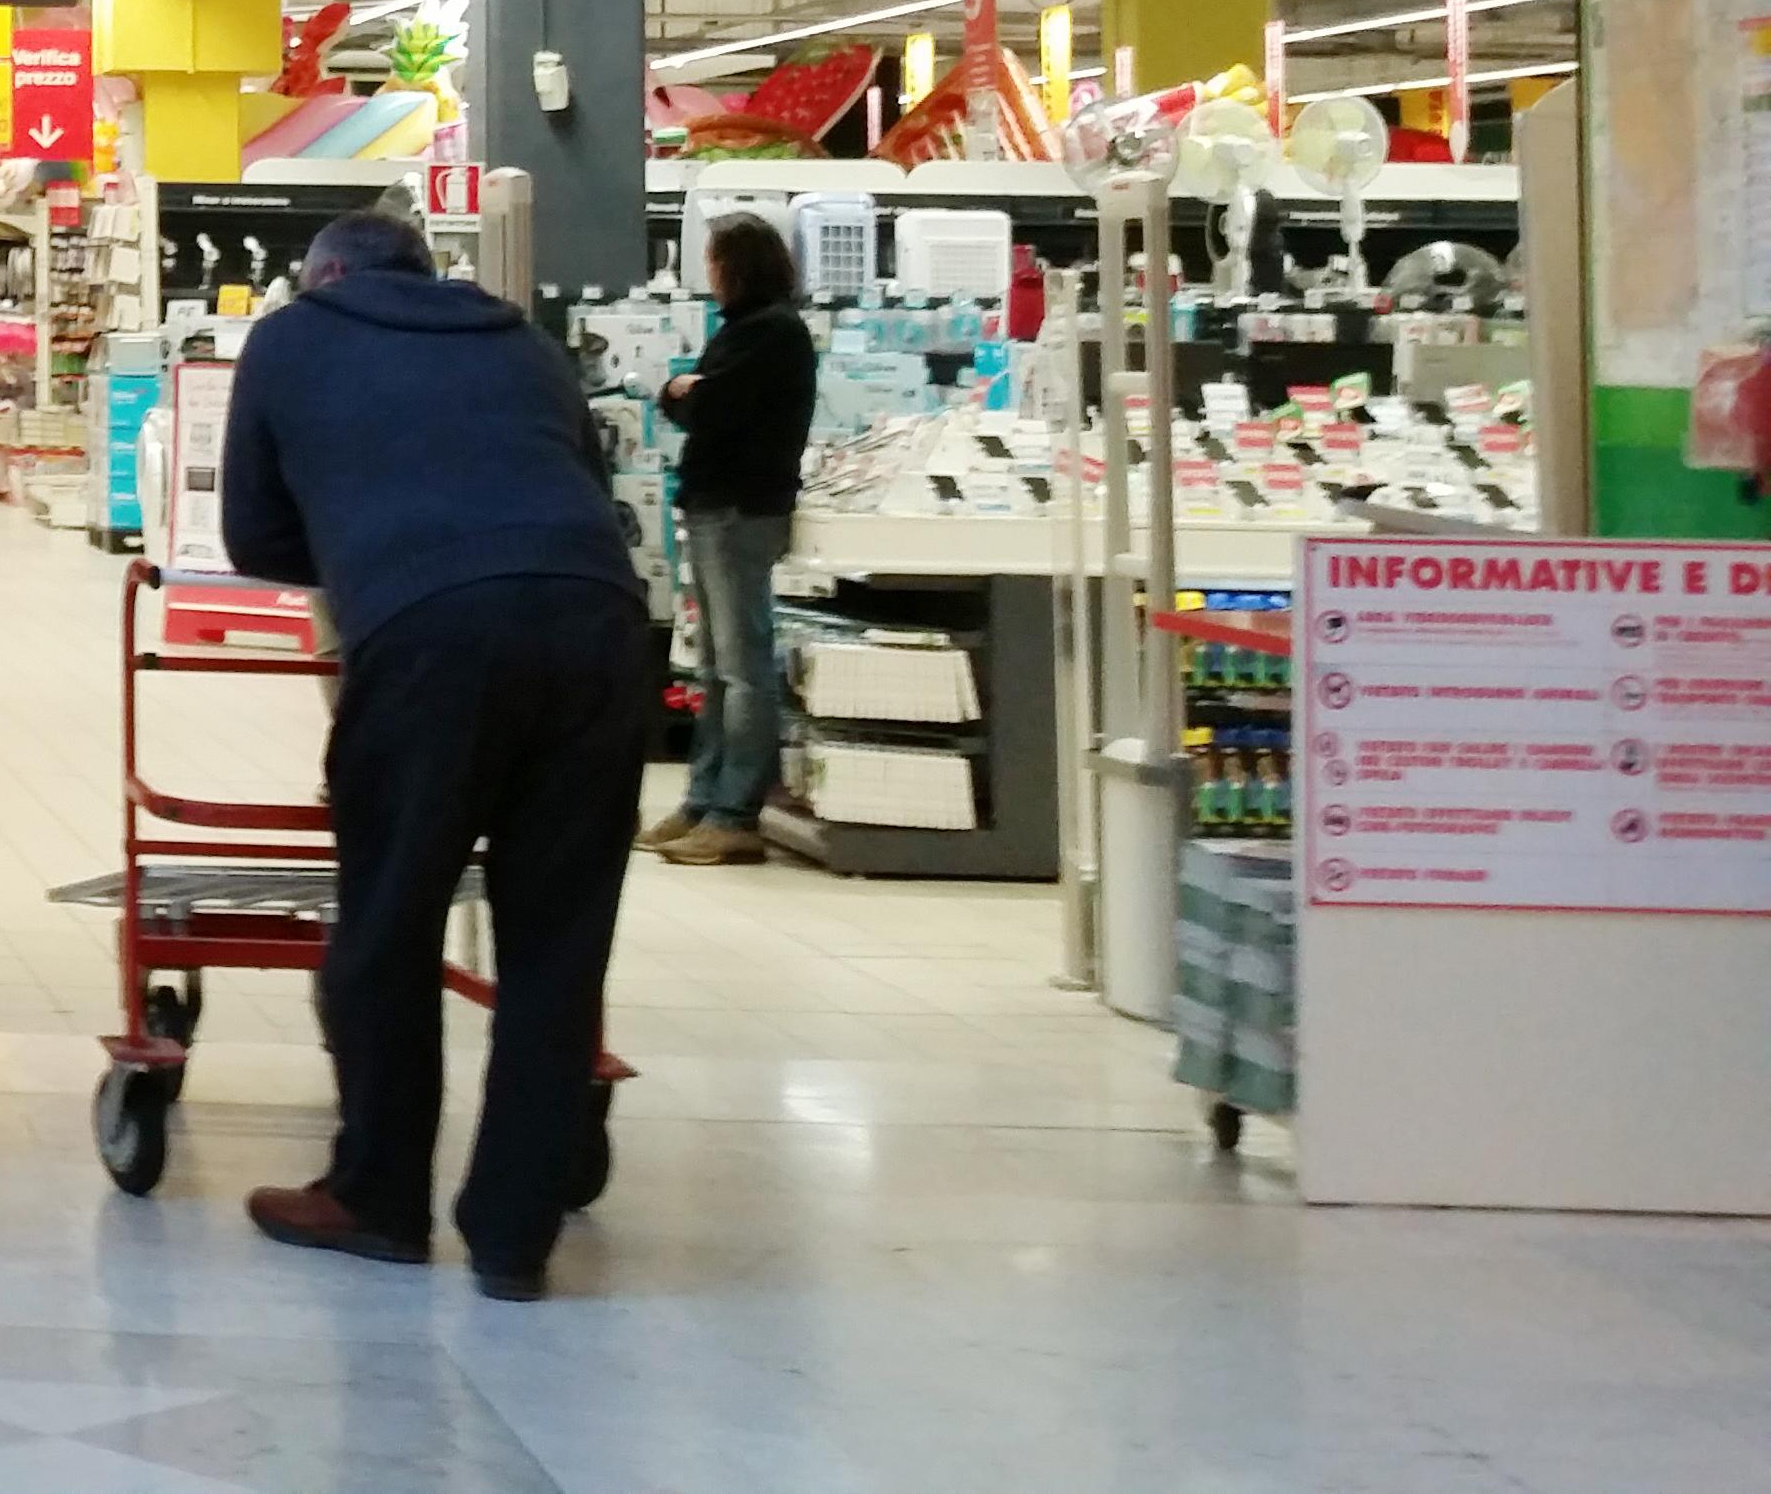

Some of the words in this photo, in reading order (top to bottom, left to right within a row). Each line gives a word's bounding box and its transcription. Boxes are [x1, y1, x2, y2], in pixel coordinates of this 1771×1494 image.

[12, 49, 81, 66] Verifica
[15, 71, 78, 89] prezzo
[1328, 555, 1661, 595] INFORMATIVE
[1683, 560, 1708, 595] E
